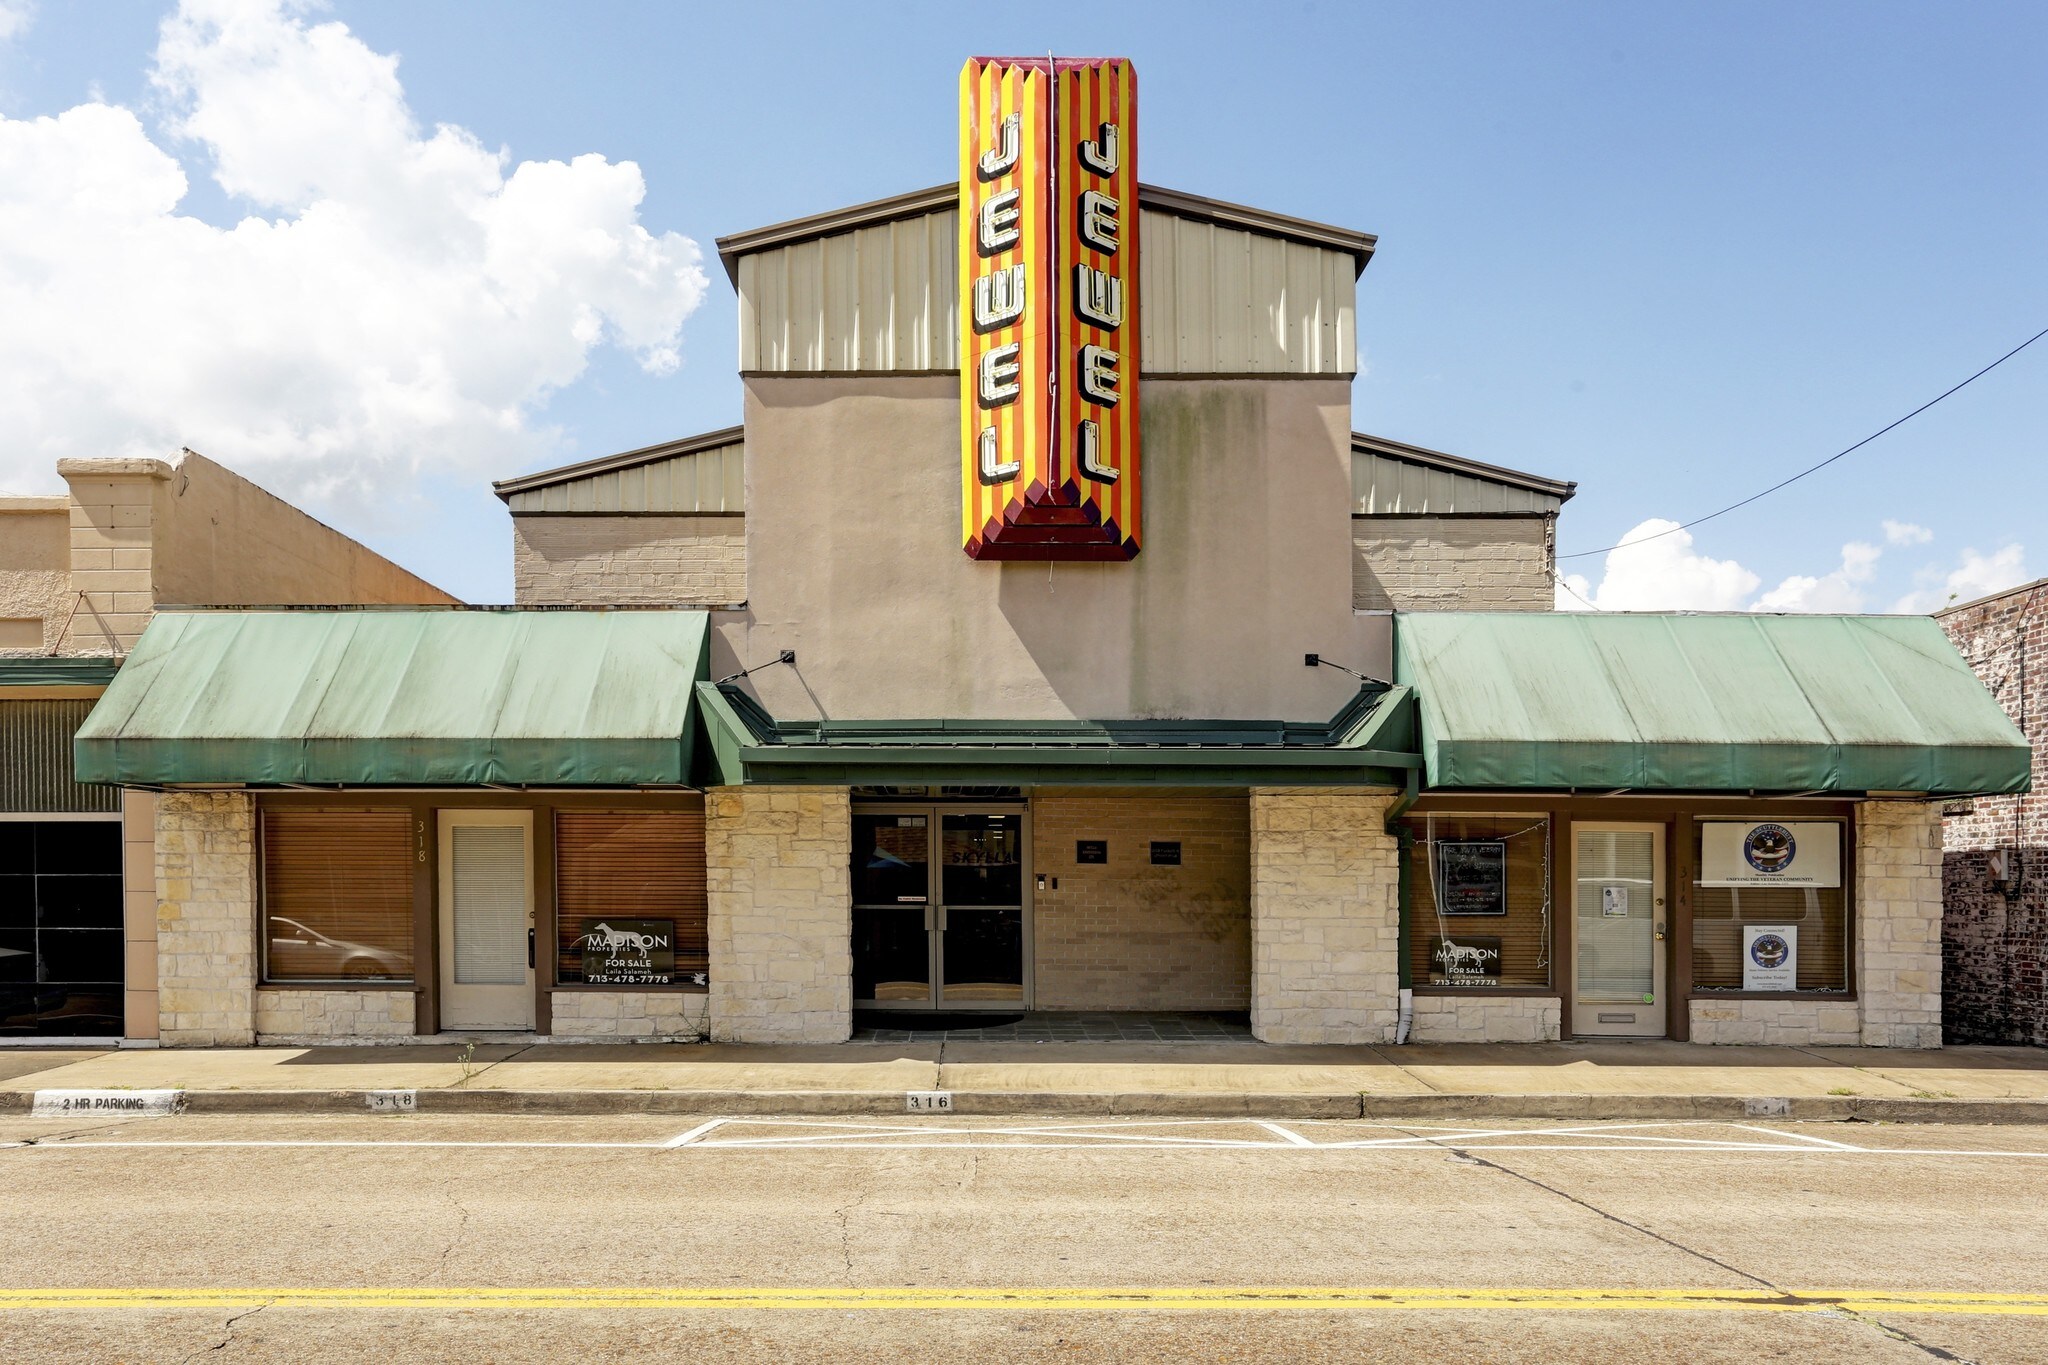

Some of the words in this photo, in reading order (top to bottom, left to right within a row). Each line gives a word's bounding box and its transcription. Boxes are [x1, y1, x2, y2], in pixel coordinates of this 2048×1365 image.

[972, 112, 1026, 486] JEWEL
[1073, 121, 1126, 486] JEWEL
[1746, 833, 1755, 843] THE
[1754, 825, 1793, 843] SCUTTLEBUTT
[417, 820, 426, 862] 318
[952, 852, 1012, 864] SKYLLA
[587, 934, 668, 948] MADISON
[1435, 949, 1498, 959] MADISON
[605, 959, 625, 967] FOR
[627, 959, 652, 968] SALE
[588, 974, 669, 983] 713-478-7778
[63, 1098, 71, 1110] 2
[74, 1098, 90, 1109] HR
[95, 1098, 144, 1110] PARKING
[375, 1094, 412, 1106] 318
[911, 1096, 948, 1108] 316
